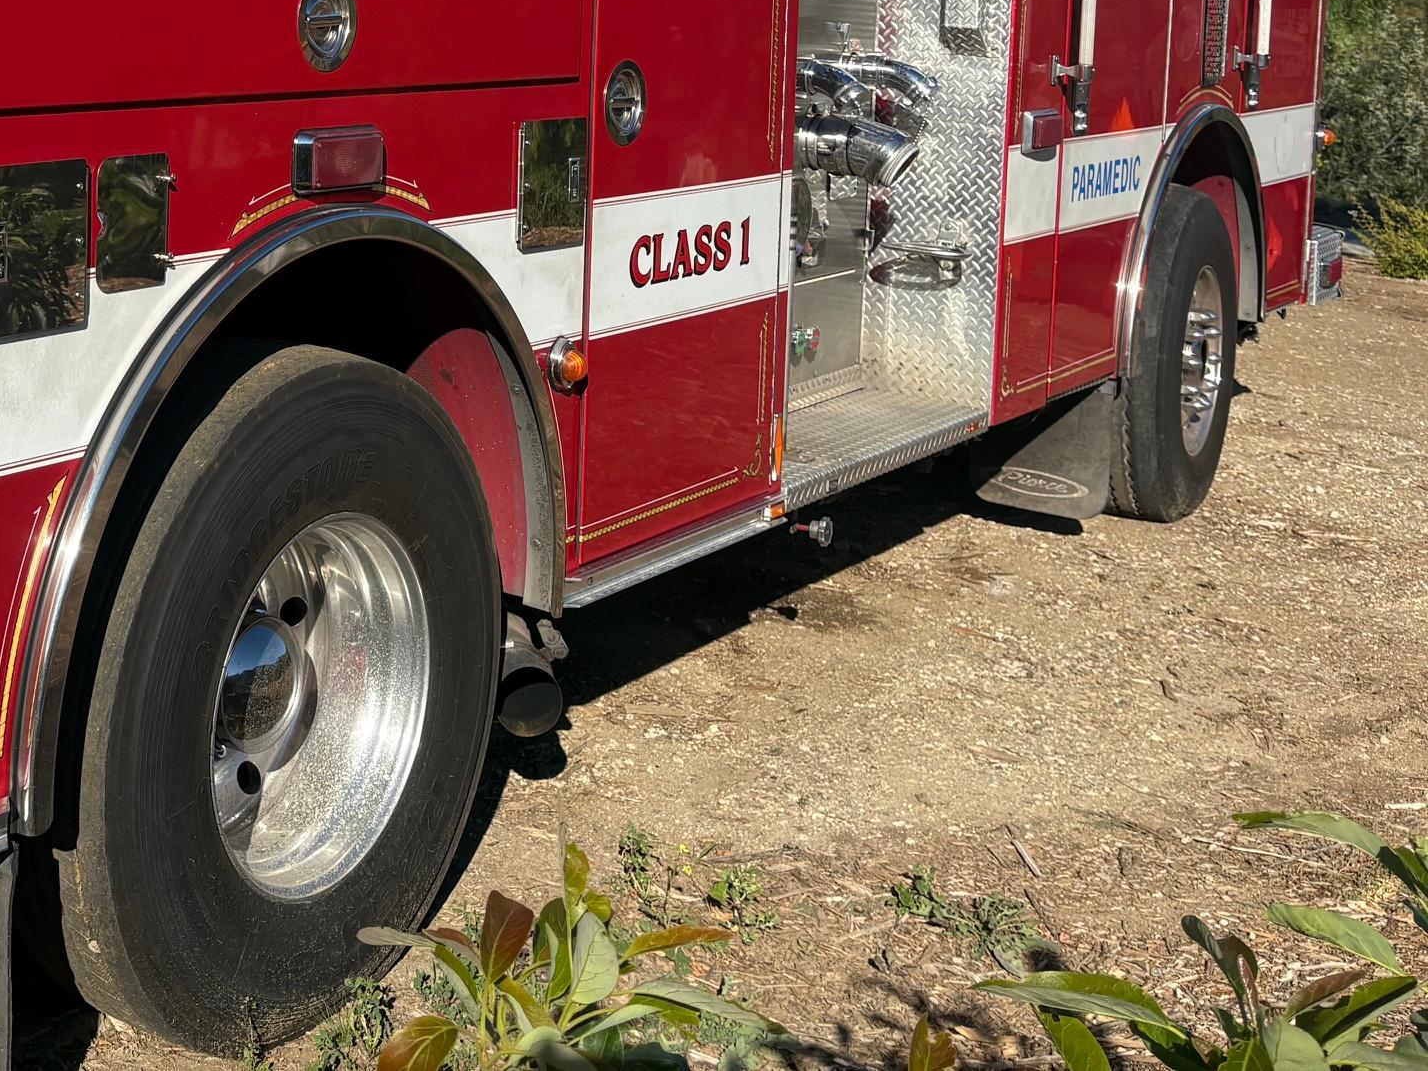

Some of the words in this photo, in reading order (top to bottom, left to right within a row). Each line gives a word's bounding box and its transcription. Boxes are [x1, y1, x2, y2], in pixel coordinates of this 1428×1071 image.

[1071, 154, 1141, 203] PARAMEDIC
[629, 220, 732, 288] CLASS
[739, 216, 751, 266] 1
[997, 470, 1068, 494] Pierce
[190, 446, 379, 681] BRIDGESTONE
